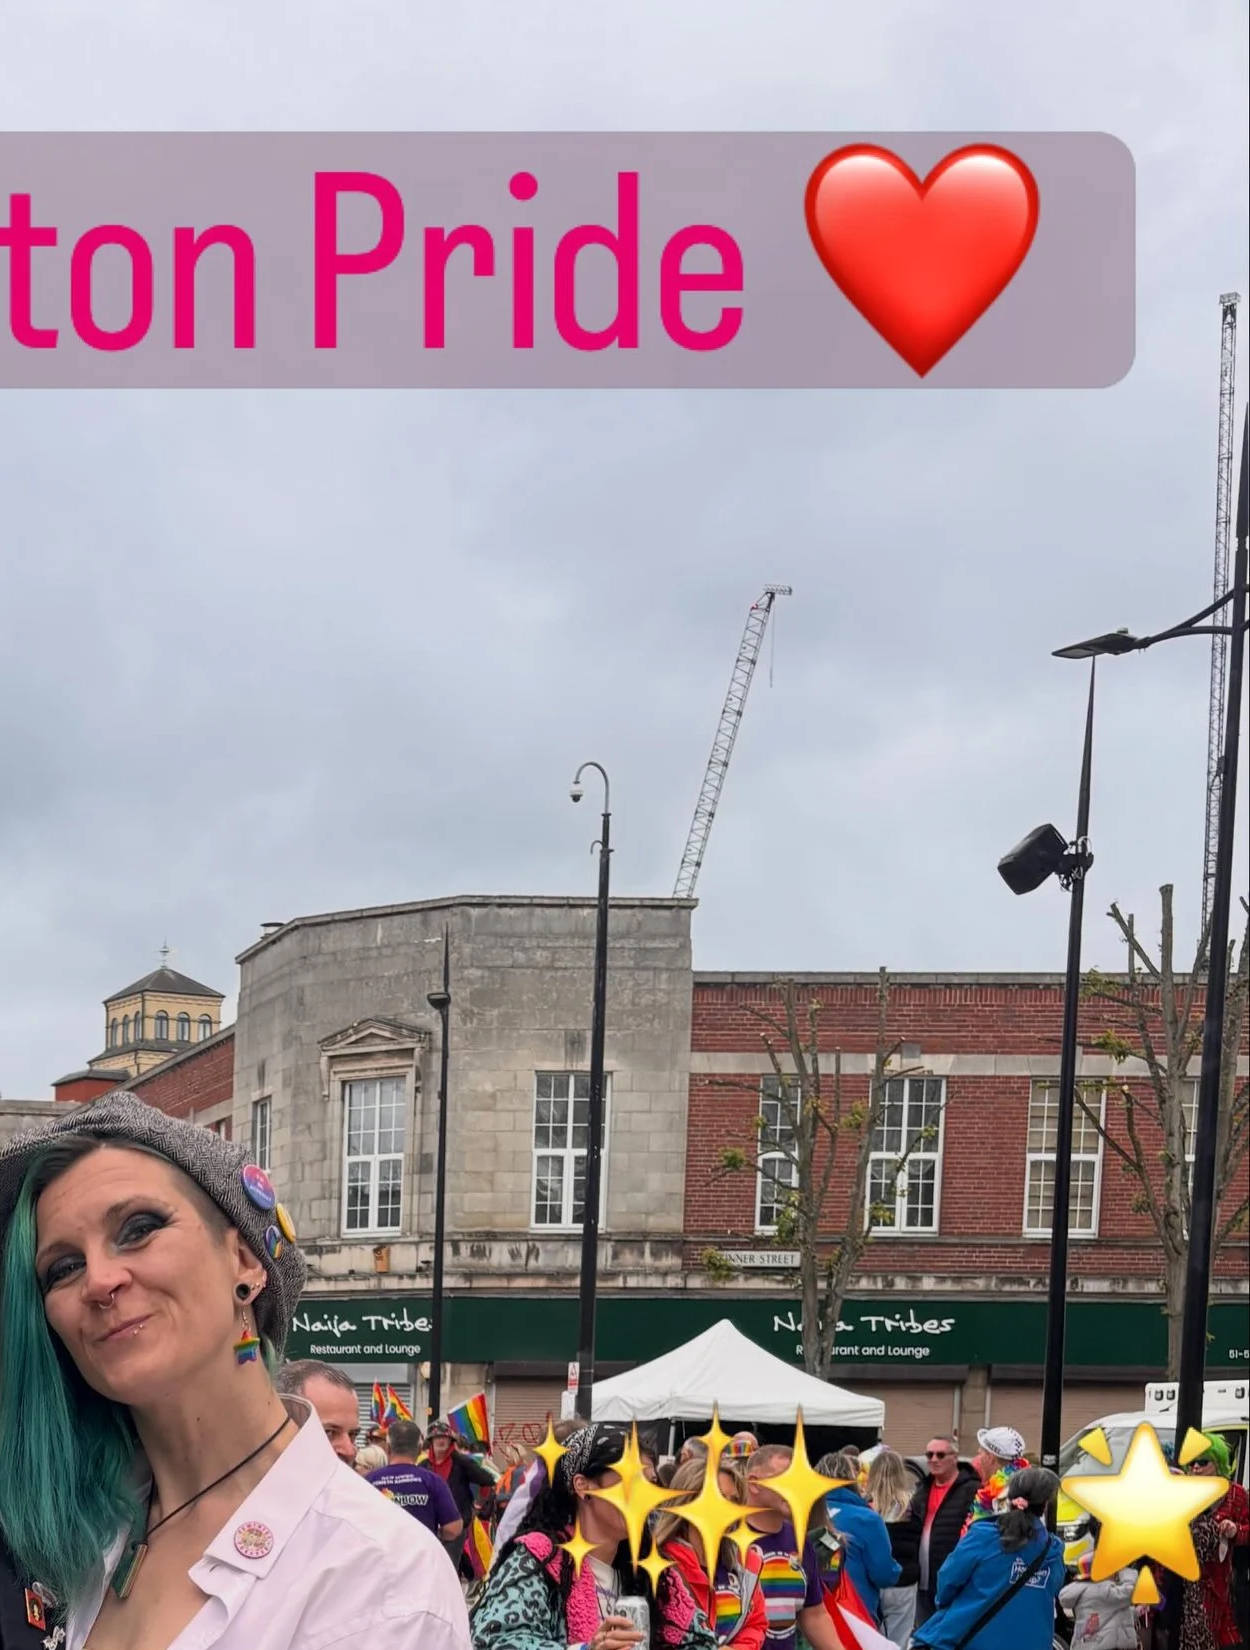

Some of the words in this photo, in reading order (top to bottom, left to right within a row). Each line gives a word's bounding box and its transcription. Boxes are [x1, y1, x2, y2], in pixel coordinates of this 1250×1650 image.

[759, 1254, 795, 1264] STREET
[292, 1312, 357, 1338] Naija
[362, 1307, 432, 1332] Tribe
[860, 1308, 955, 1334] Tribes
[310, 1344, 361, 1354] Restaurant
[363, 1344, 383, 1354] and
[385, 1344, 421, 1357] Lounge
[862, 1344, 886, 1355] and
[888, 1345, 930, 1359] Lounge
